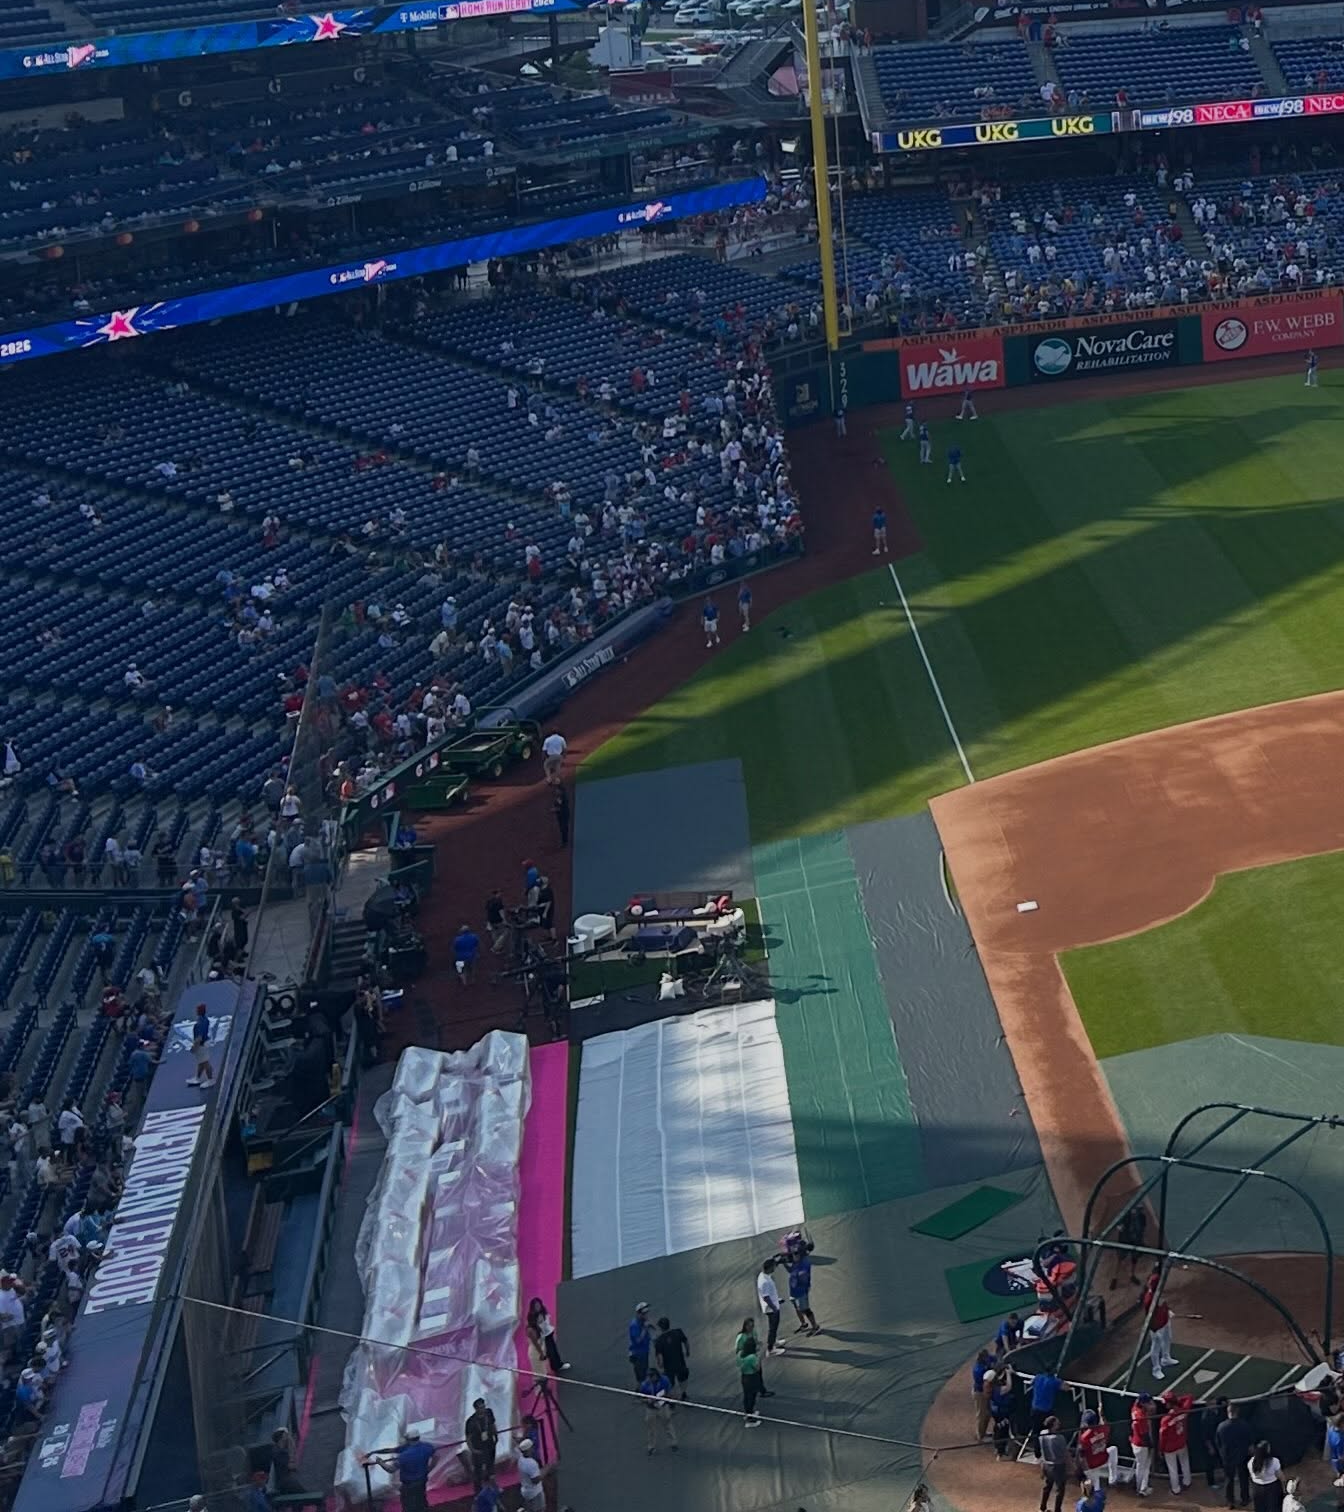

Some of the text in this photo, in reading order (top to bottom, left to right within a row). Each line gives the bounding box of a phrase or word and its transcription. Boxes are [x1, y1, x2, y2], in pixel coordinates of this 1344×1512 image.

[409, 10, 438, 22] Mobile
[460, 0, 486, 18] HOME
[486, 0, 504, 14] RUN
[1200, 105, 1248, 123] NECA
[975, 123, 1019, 143] UKG
[1052, 116, 1095, 135] UKG
[898, 130, 942, 148] UKG
[1254, 289, 1324, 307] ASPLUNDH
[1168, 299, 1240, 316] ASPLUNDH
[1081, 309, 1154, 326] ASPLUNDH
[1286, 313, 1335, 330] WEBB
[993, 319, 1067, 337] ASPLUNDH
[1272, 329, 1316, 343] COMPANY
[0, 338, 31, 357] 2026
[901, 330, 977, 347] ASPLUNDH
[1074, 330, 1174, 359] NovaCare
[1076, 350, 1171, 371] REHABILITATION
[906, 359, 998, 391] Wawa
[84, 1103, 207, 1316] AMERICAN LEAGUE
